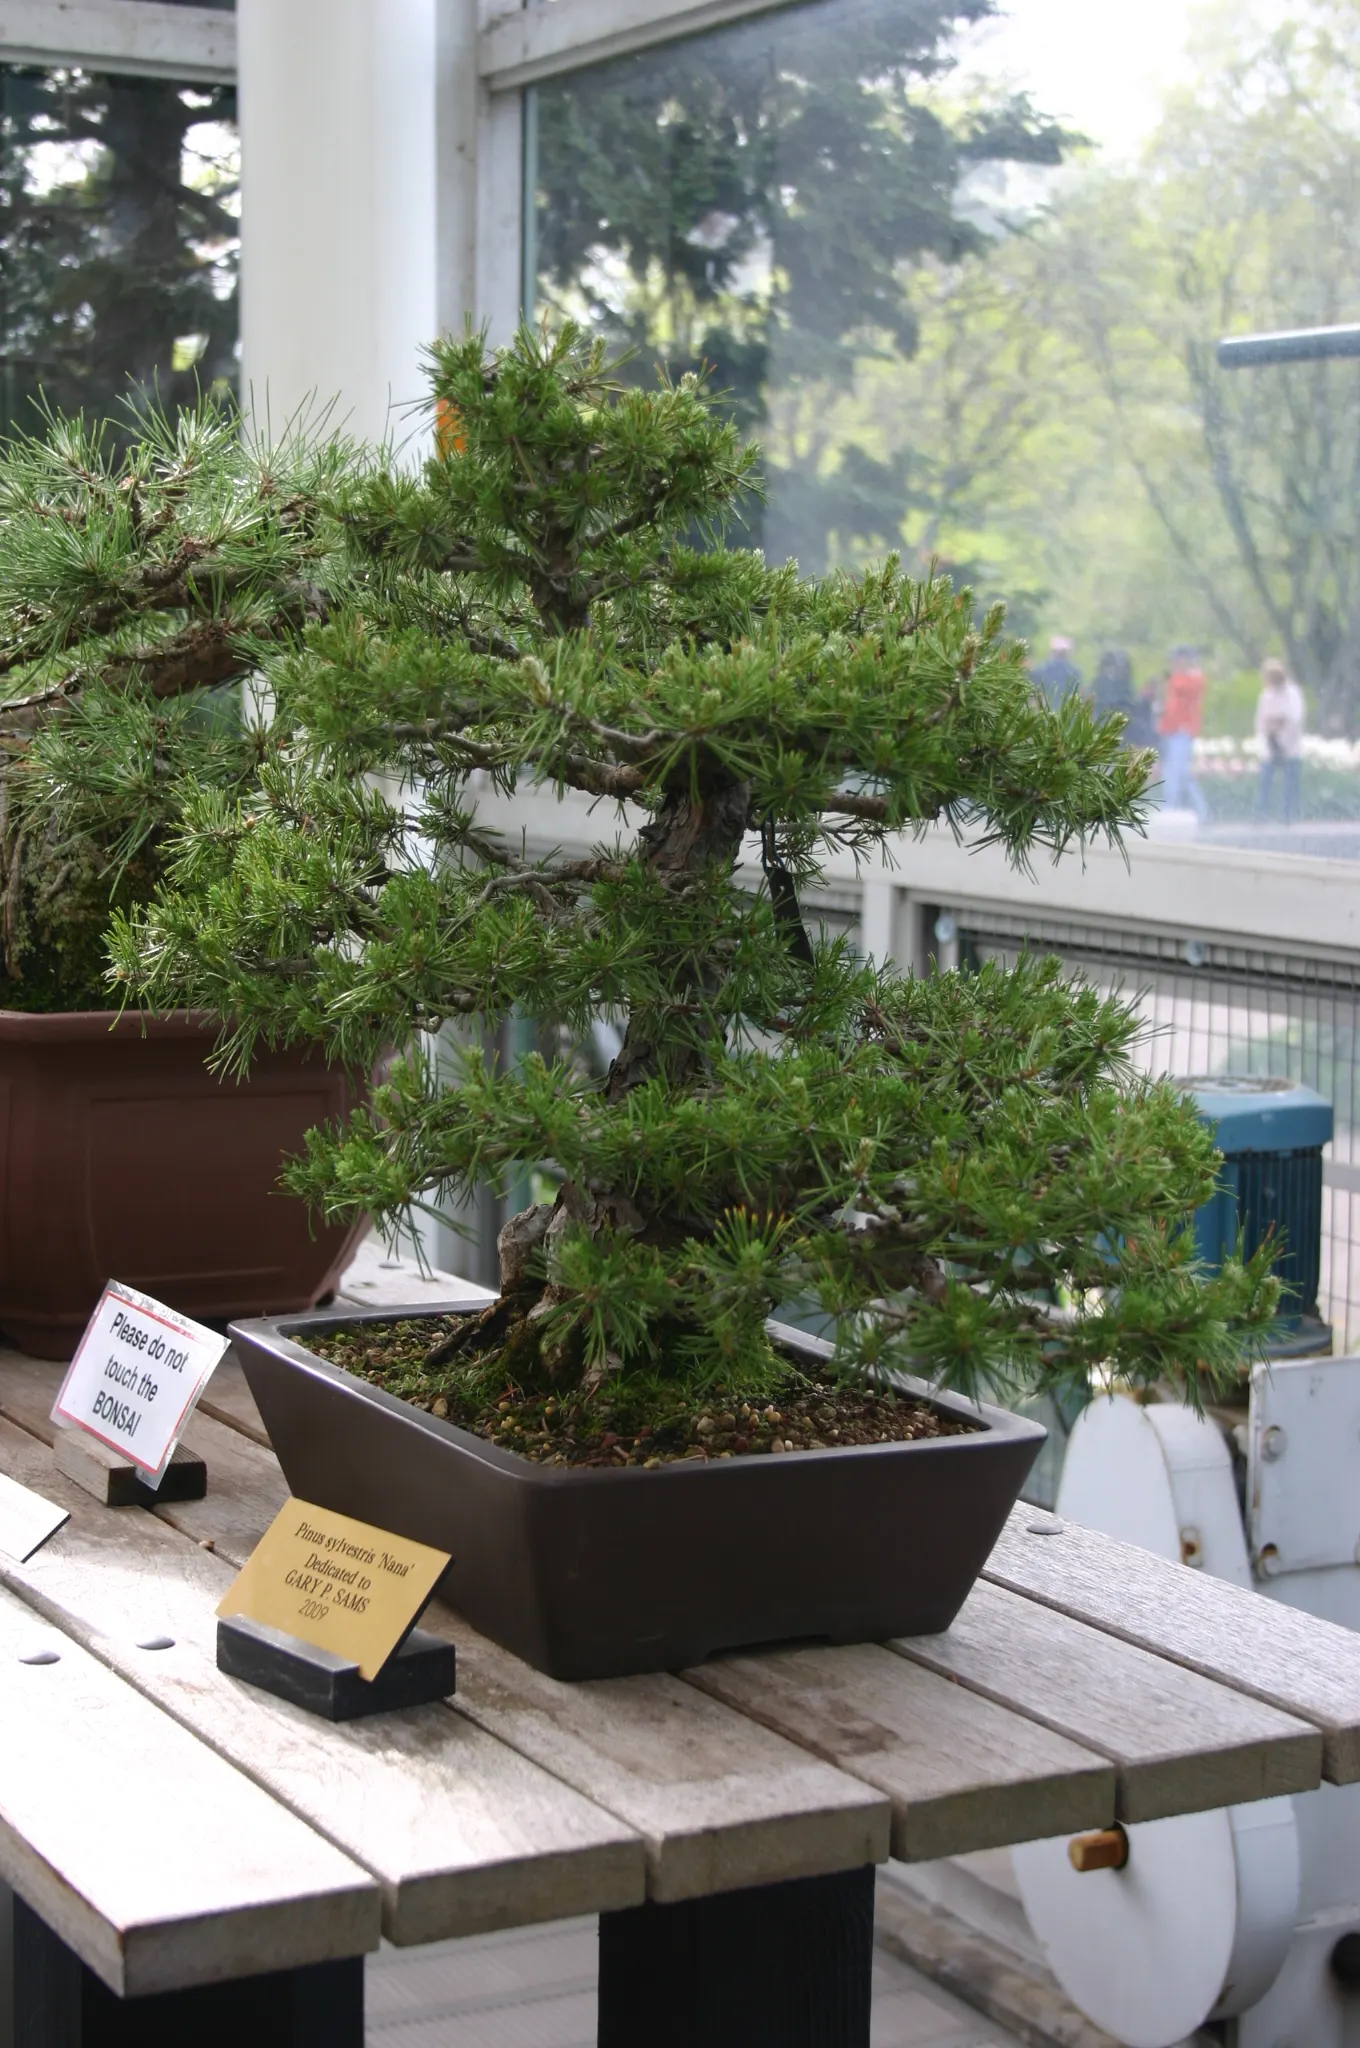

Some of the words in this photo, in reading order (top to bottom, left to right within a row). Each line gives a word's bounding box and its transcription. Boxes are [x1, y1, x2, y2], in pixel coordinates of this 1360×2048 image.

[109, 1312, 149, 1350] Please
[147, 1334, 166, 1360] do
[164, 1348, 189, 1374] not
[104, 1354, 138, 1391] touch
[136, 1373, 158, 1402] the
[92, 1390, 142, 1437] BONSAI
[294, 1522, 326, 1545] Pinus
[325, 1537, 376, 1564] sylvestris
[378, 1552, 415, 1577] 'Nana'
[304, 1553, 359, 1585] Dedicated
[357, 1577, 371, 1590] to
[285, 1569, 322, 1595] GARY
[320, 1583, 333, 1600] P.
[333, 1589, 370, 1613] SAMS
[298, 1599, 329, 1620] 2009
